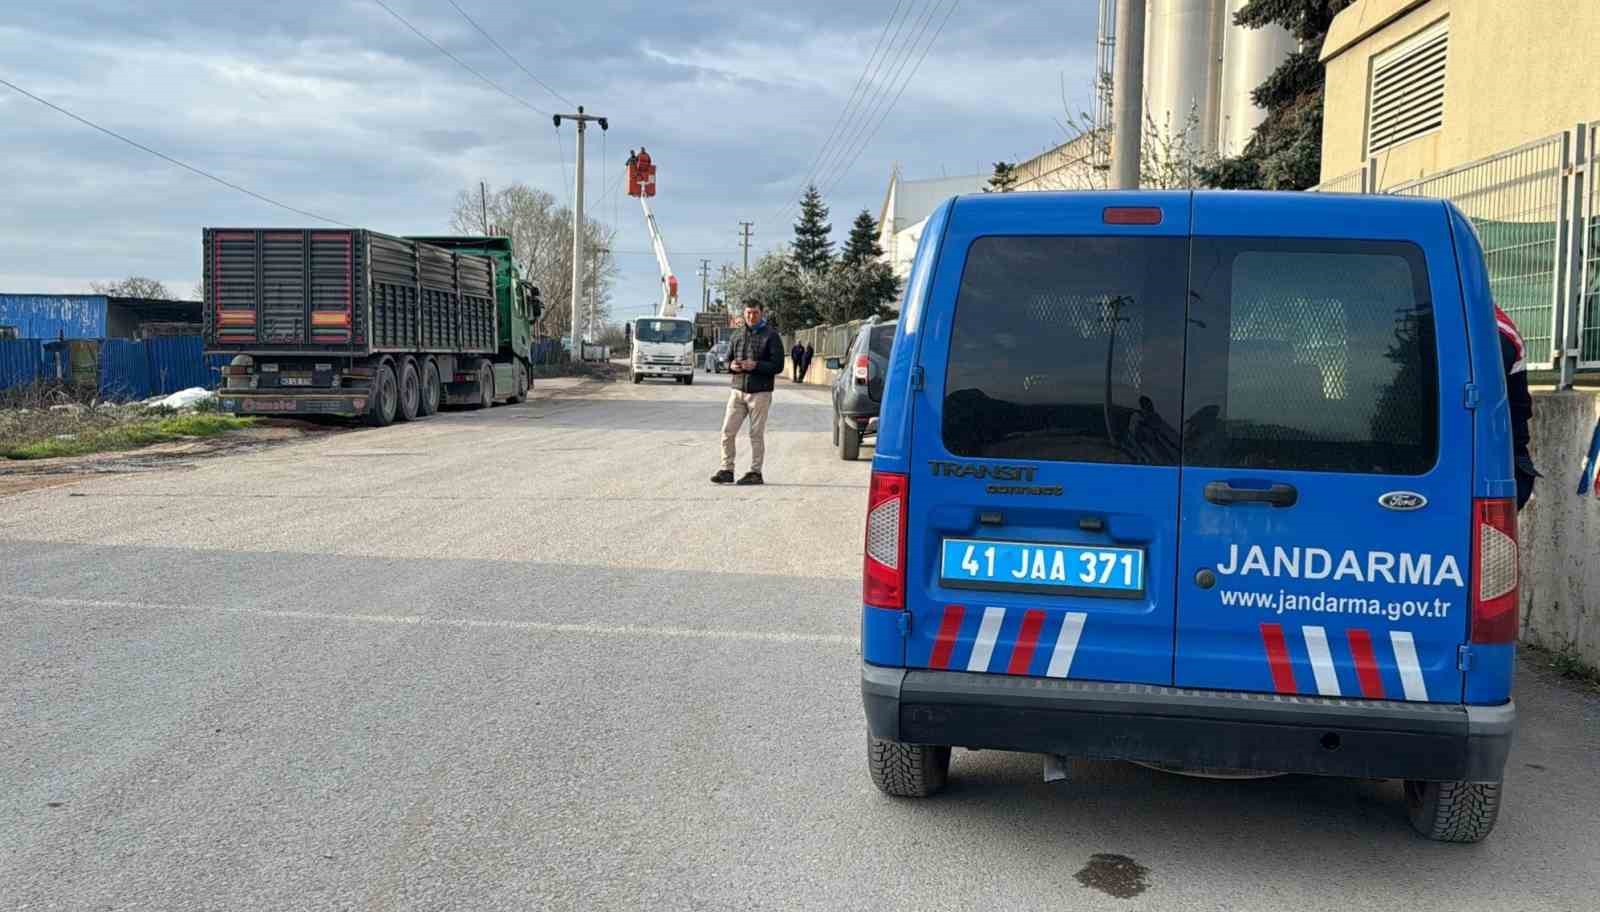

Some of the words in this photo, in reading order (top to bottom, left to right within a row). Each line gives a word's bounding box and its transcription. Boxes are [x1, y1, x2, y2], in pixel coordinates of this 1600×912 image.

[928, 460, 1039, 482] TRANSIT
[986, 483, 1064, 497] connect
[961, 544, 997, 577] 41
[1011, 548, 1066, 581] JAA
[1079, 551, 1134, 586] 371
[1216, 543, 1465, 587] JANDARMA
[1219, 588, 1452, 621] www.jandarma.gov.tr
